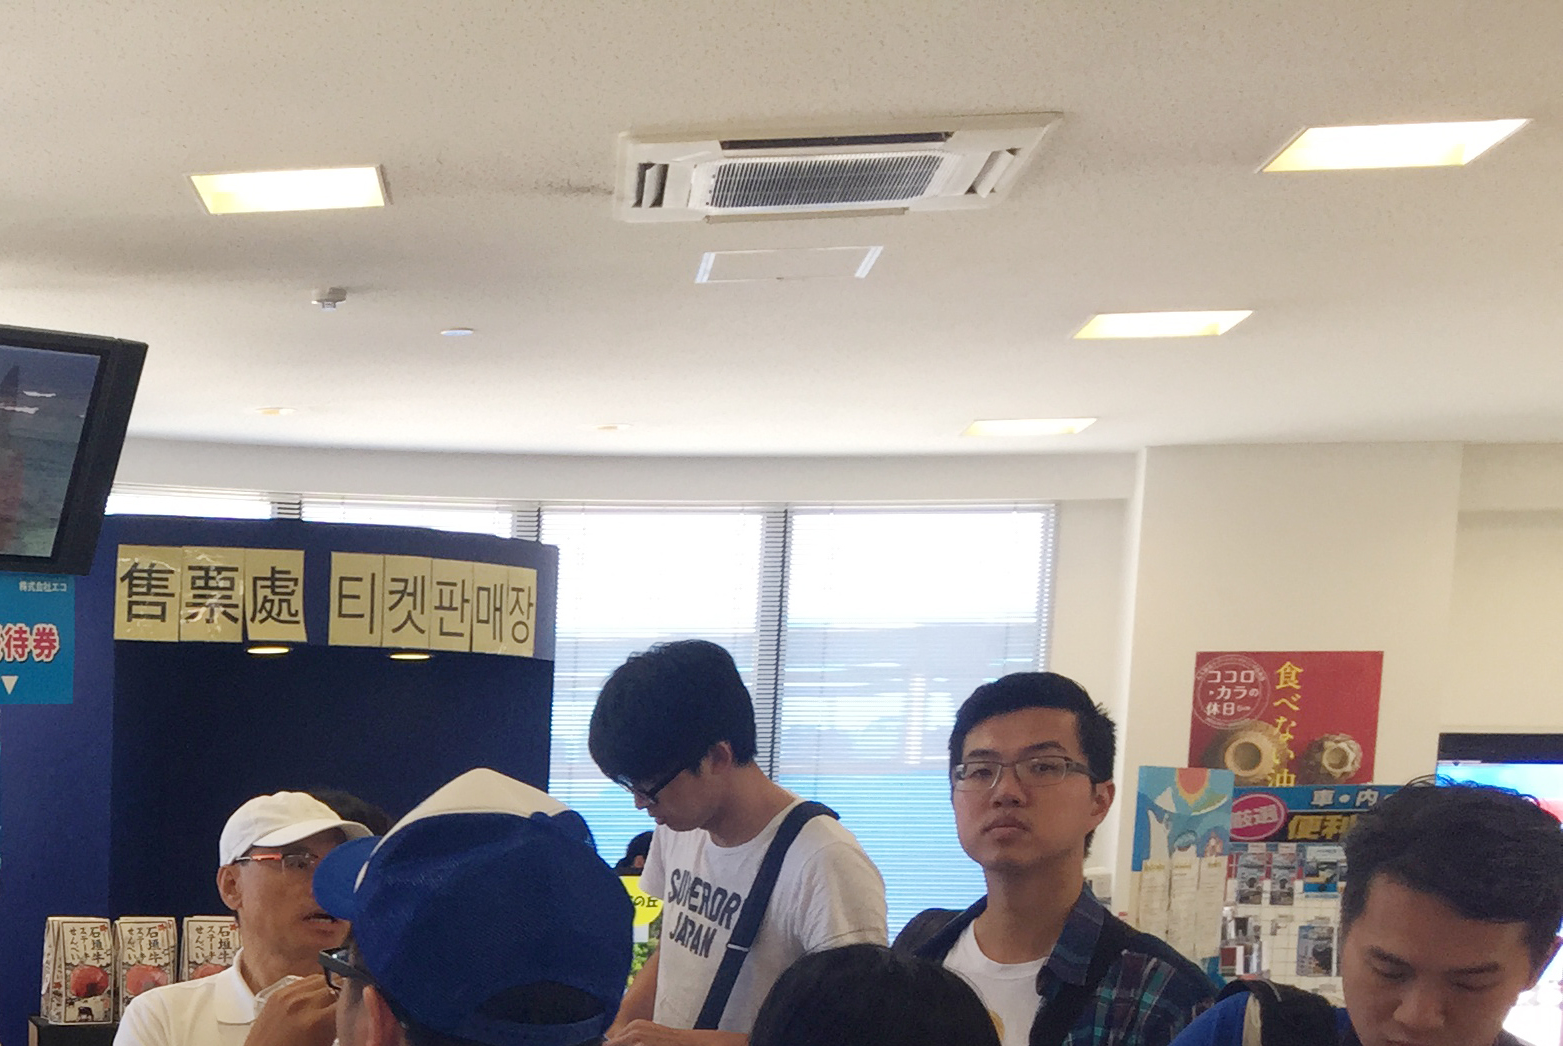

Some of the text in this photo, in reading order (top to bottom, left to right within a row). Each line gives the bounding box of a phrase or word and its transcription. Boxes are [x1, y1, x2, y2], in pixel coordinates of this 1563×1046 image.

[119, 559, 302, 626] 售票處
[1207, 669, 1255, 684] ココロ
[669, 911, 717, 958] JAPAN
